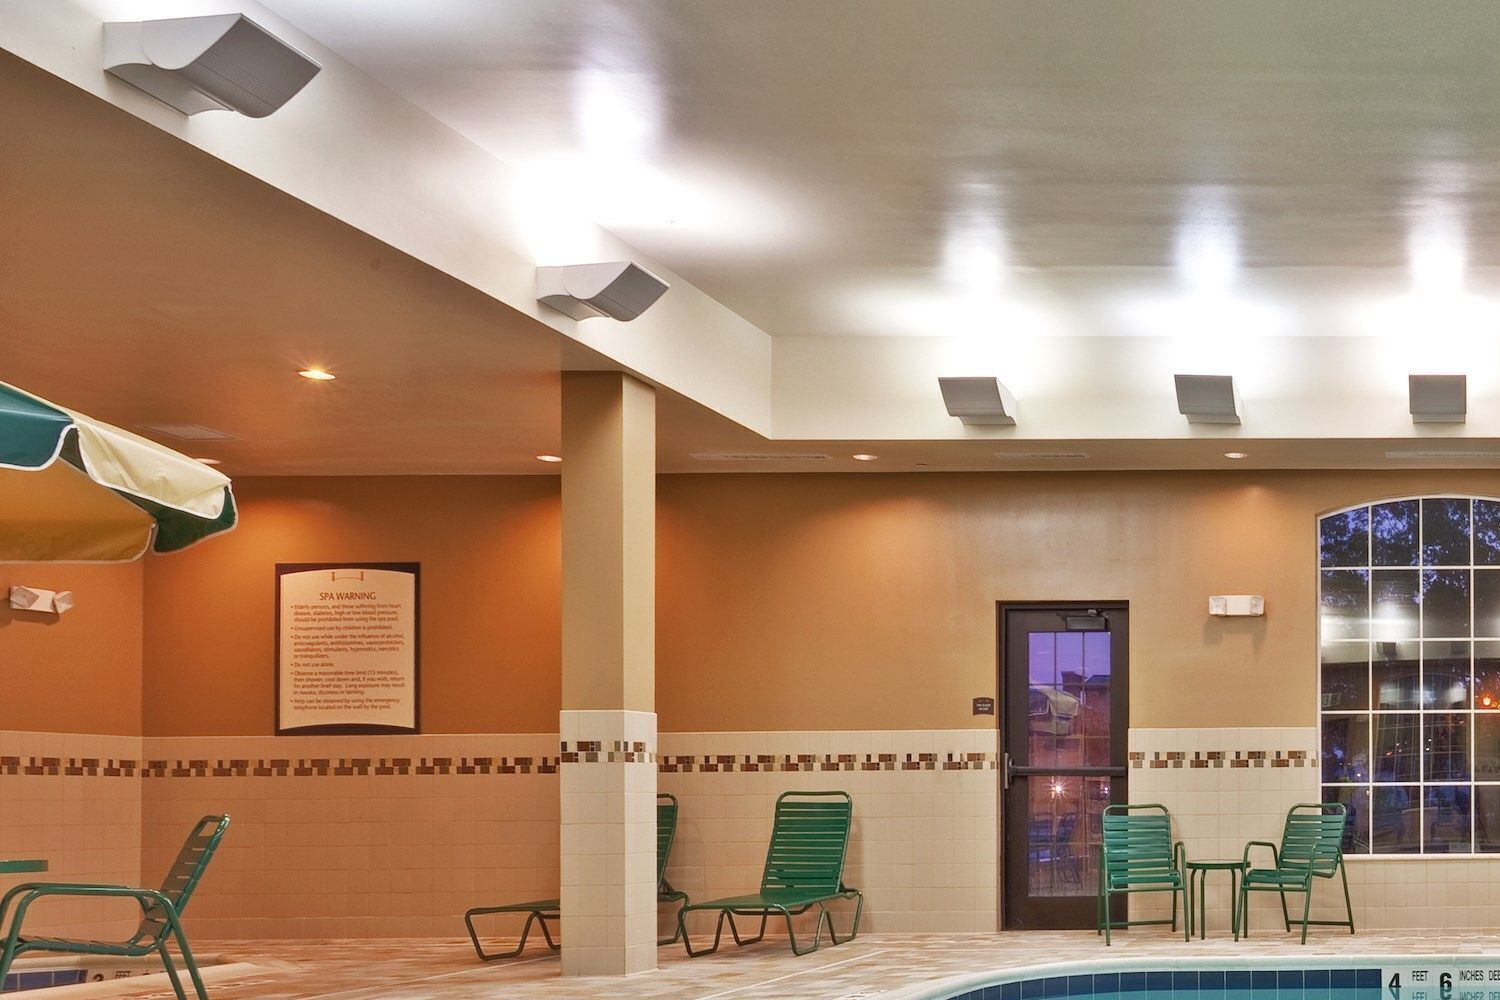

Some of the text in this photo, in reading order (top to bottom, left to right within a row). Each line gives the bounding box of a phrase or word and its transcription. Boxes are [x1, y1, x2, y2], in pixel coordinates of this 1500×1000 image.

[319, 592, 376, 601] SPA WARNING
[1389, 972, 1401, 988] 4
[1412, 970, 1428, 981] FEET
[1440, 972, 1452, 988] 6
[1459, 970, 1484, 981] INCHES
